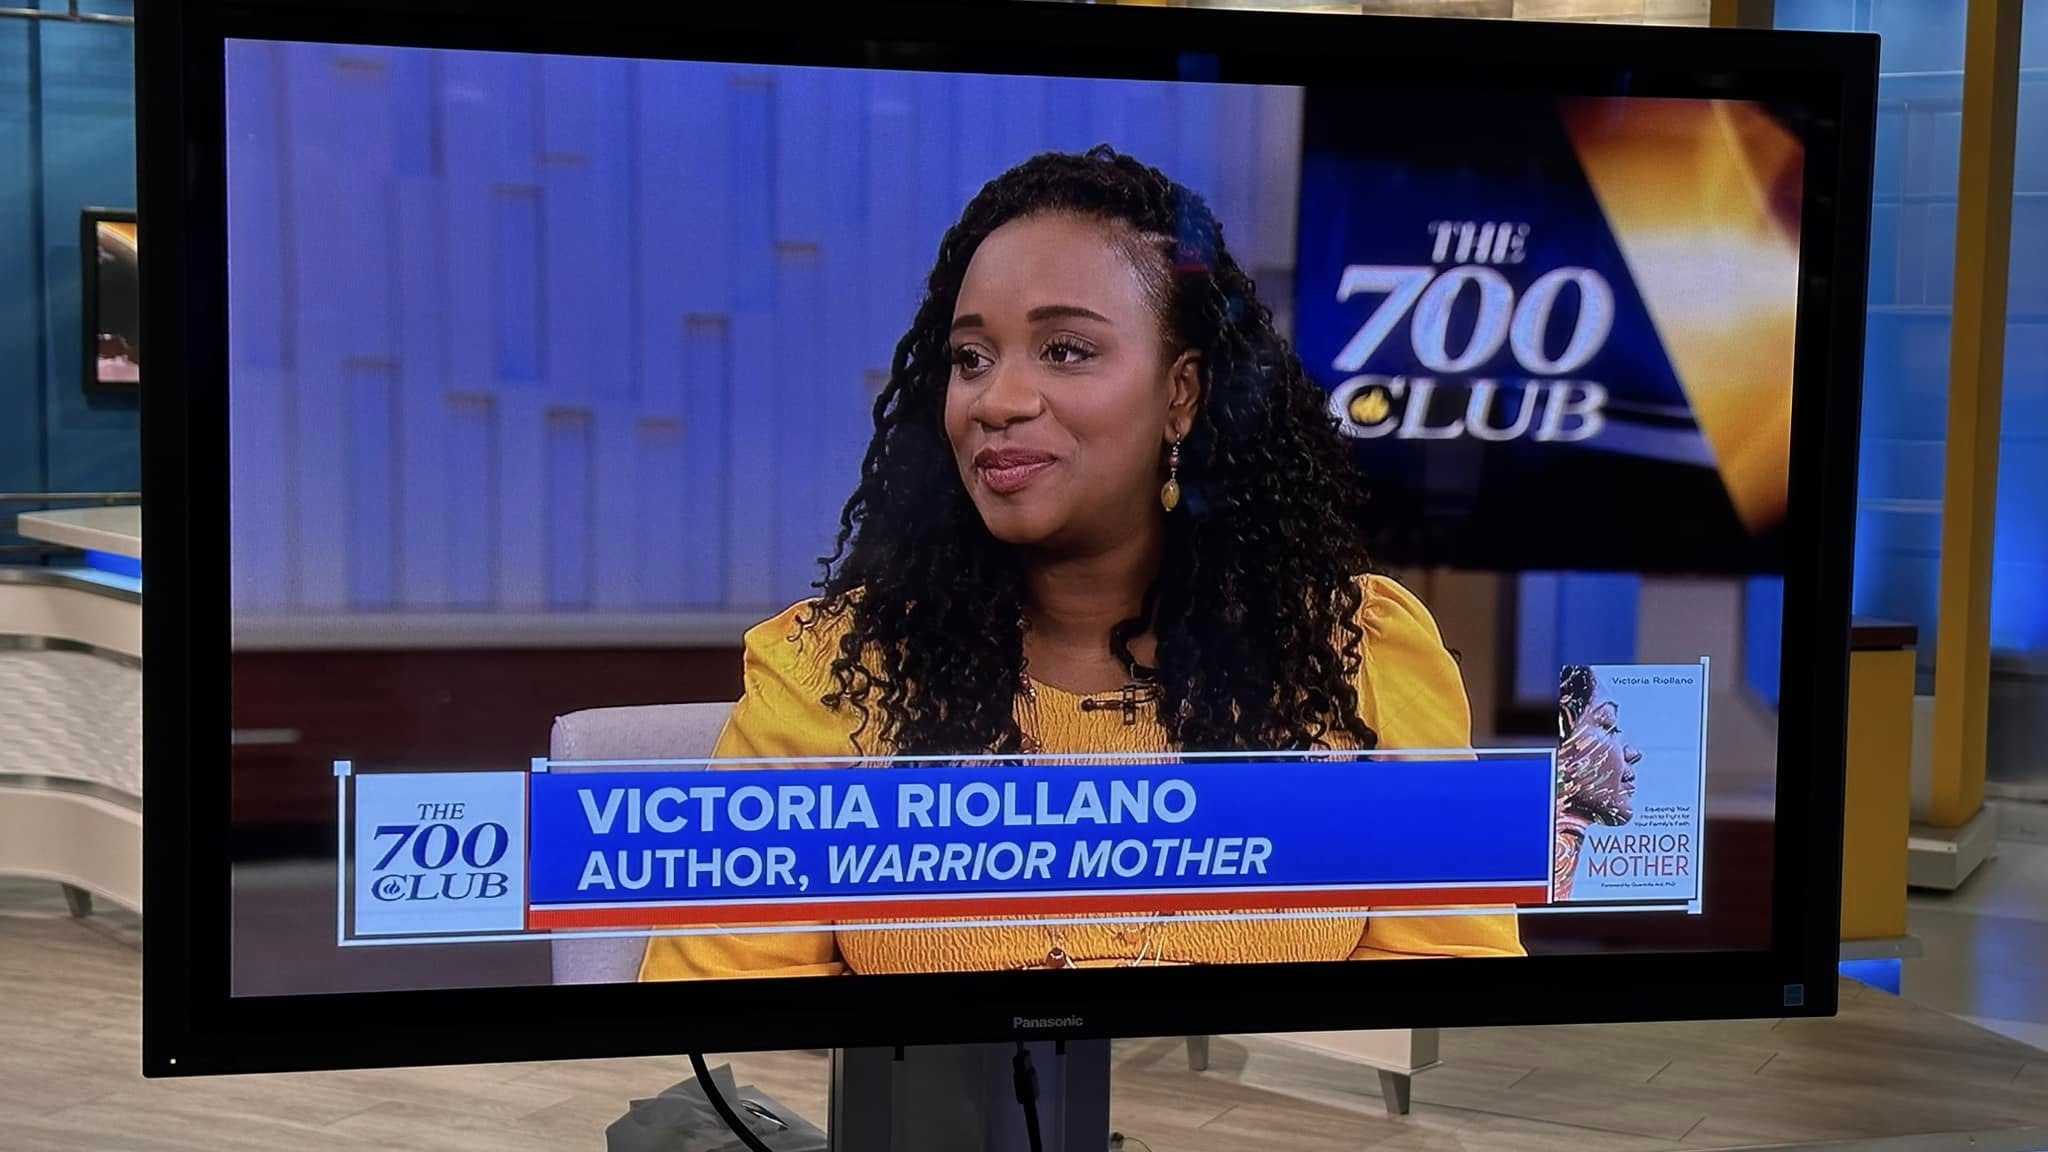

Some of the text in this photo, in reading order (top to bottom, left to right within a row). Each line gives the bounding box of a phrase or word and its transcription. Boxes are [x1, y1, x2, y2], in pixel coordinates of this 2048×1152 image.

[1428, 221, 1530, 263] THE
[1332, 264, 1615, 375] 700
[1328, 374, 1608, 441] CLUB
[1612, 676, 1694, 685] Victoria Riollano
[418, 803, 465, 820] THE
[577, 779, 1197, 834] VICTORIA RIOLLANO
[372, 822, 509, 871] 700
[1588, 834, 1690, 854] WARRIOR
[577, 837, 1273, 891] AUTHOR, WARRIOR MOTHER
[1588, 855, 1689, 877] MOTHER
[371, 872, 509, 901] CLUB
[1013, 1014, 1083, 1029] Panasonic
